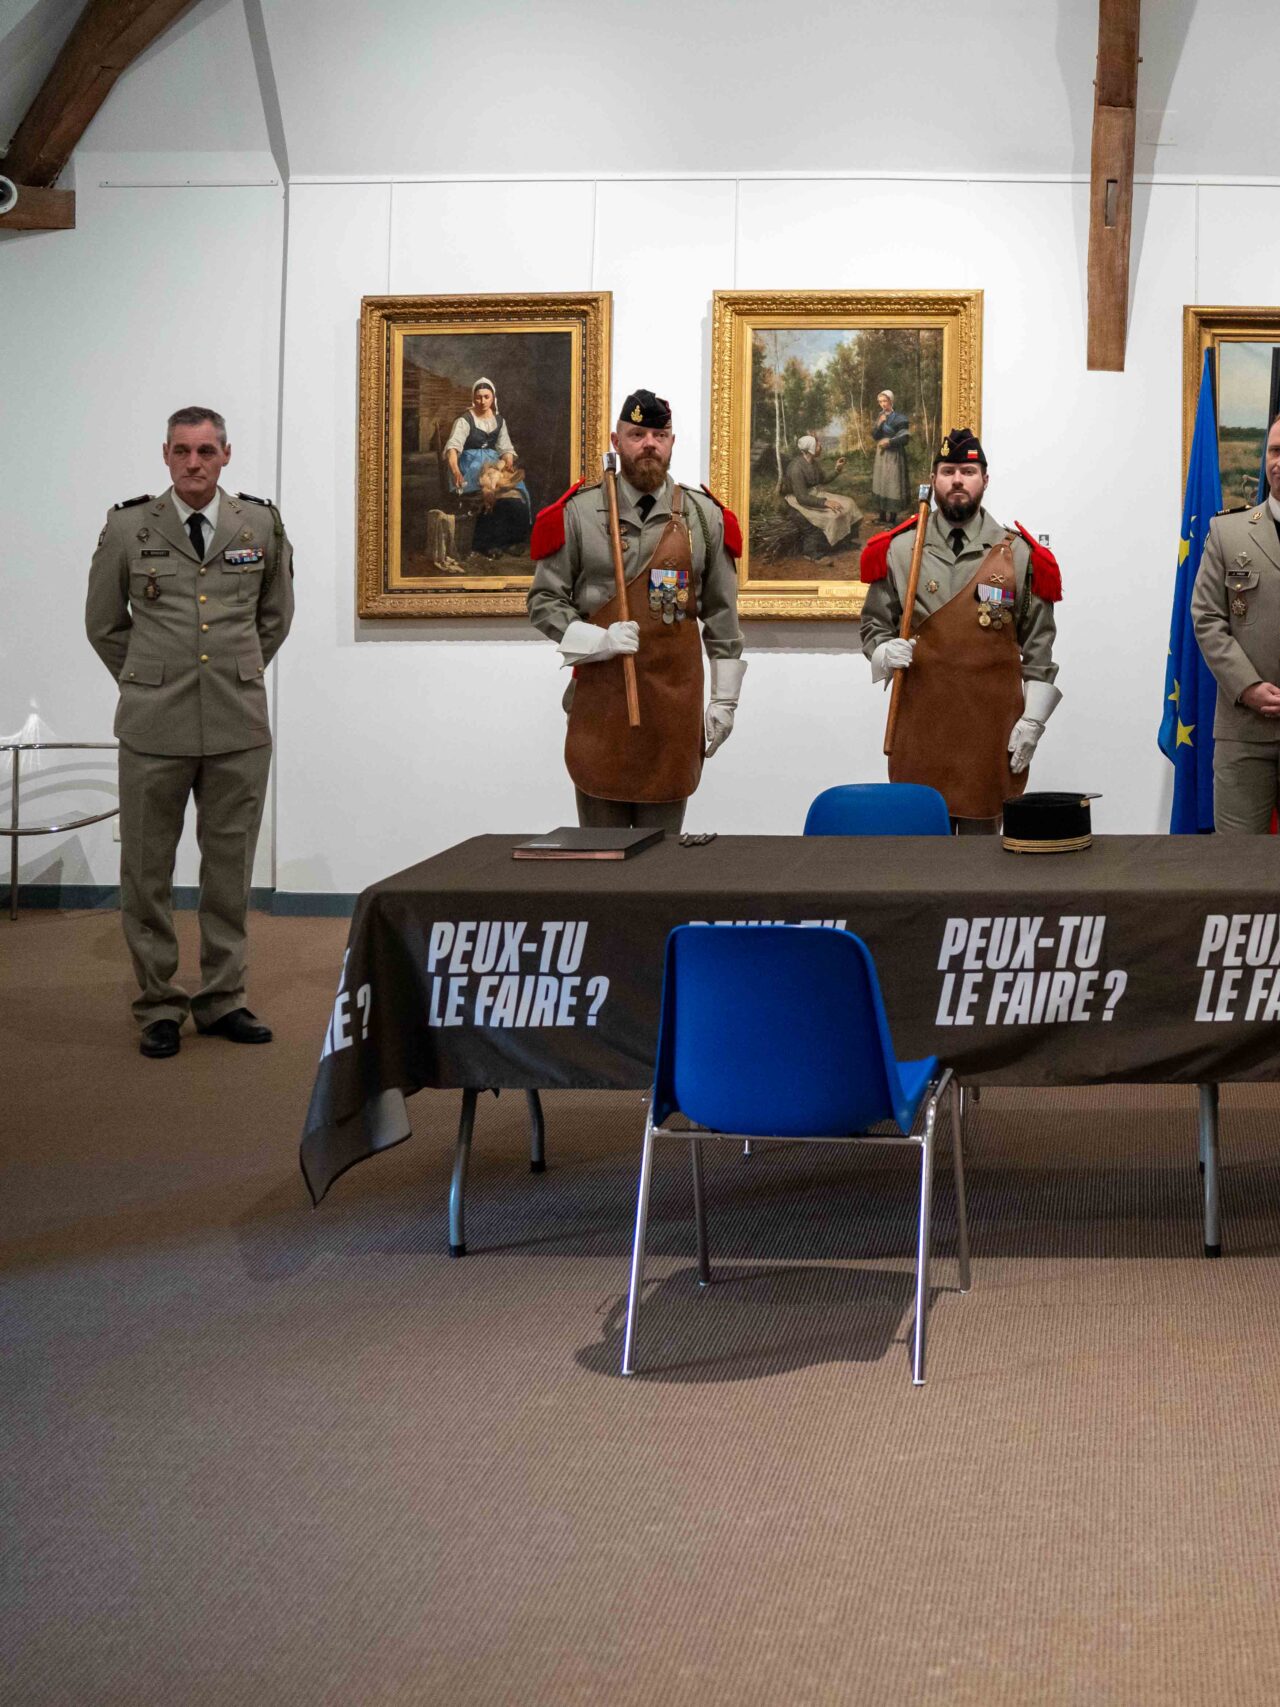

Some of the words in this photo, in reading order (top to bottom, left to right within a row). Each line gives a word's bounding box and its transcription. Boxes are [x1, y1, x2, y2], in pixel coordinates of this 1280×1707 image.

[428, 922, 588, 973] PEUX-TU
[937, 916, 1106, 970] PEUX-TU
[429, 976, 468, 1026] LE
[474, 976, 581, 1027] FAIRE
[936, 972, 983, 1025] LE
[986, 971, 1099, 1025] FAIRE
[1195, 969, 1242, 1022] LE
